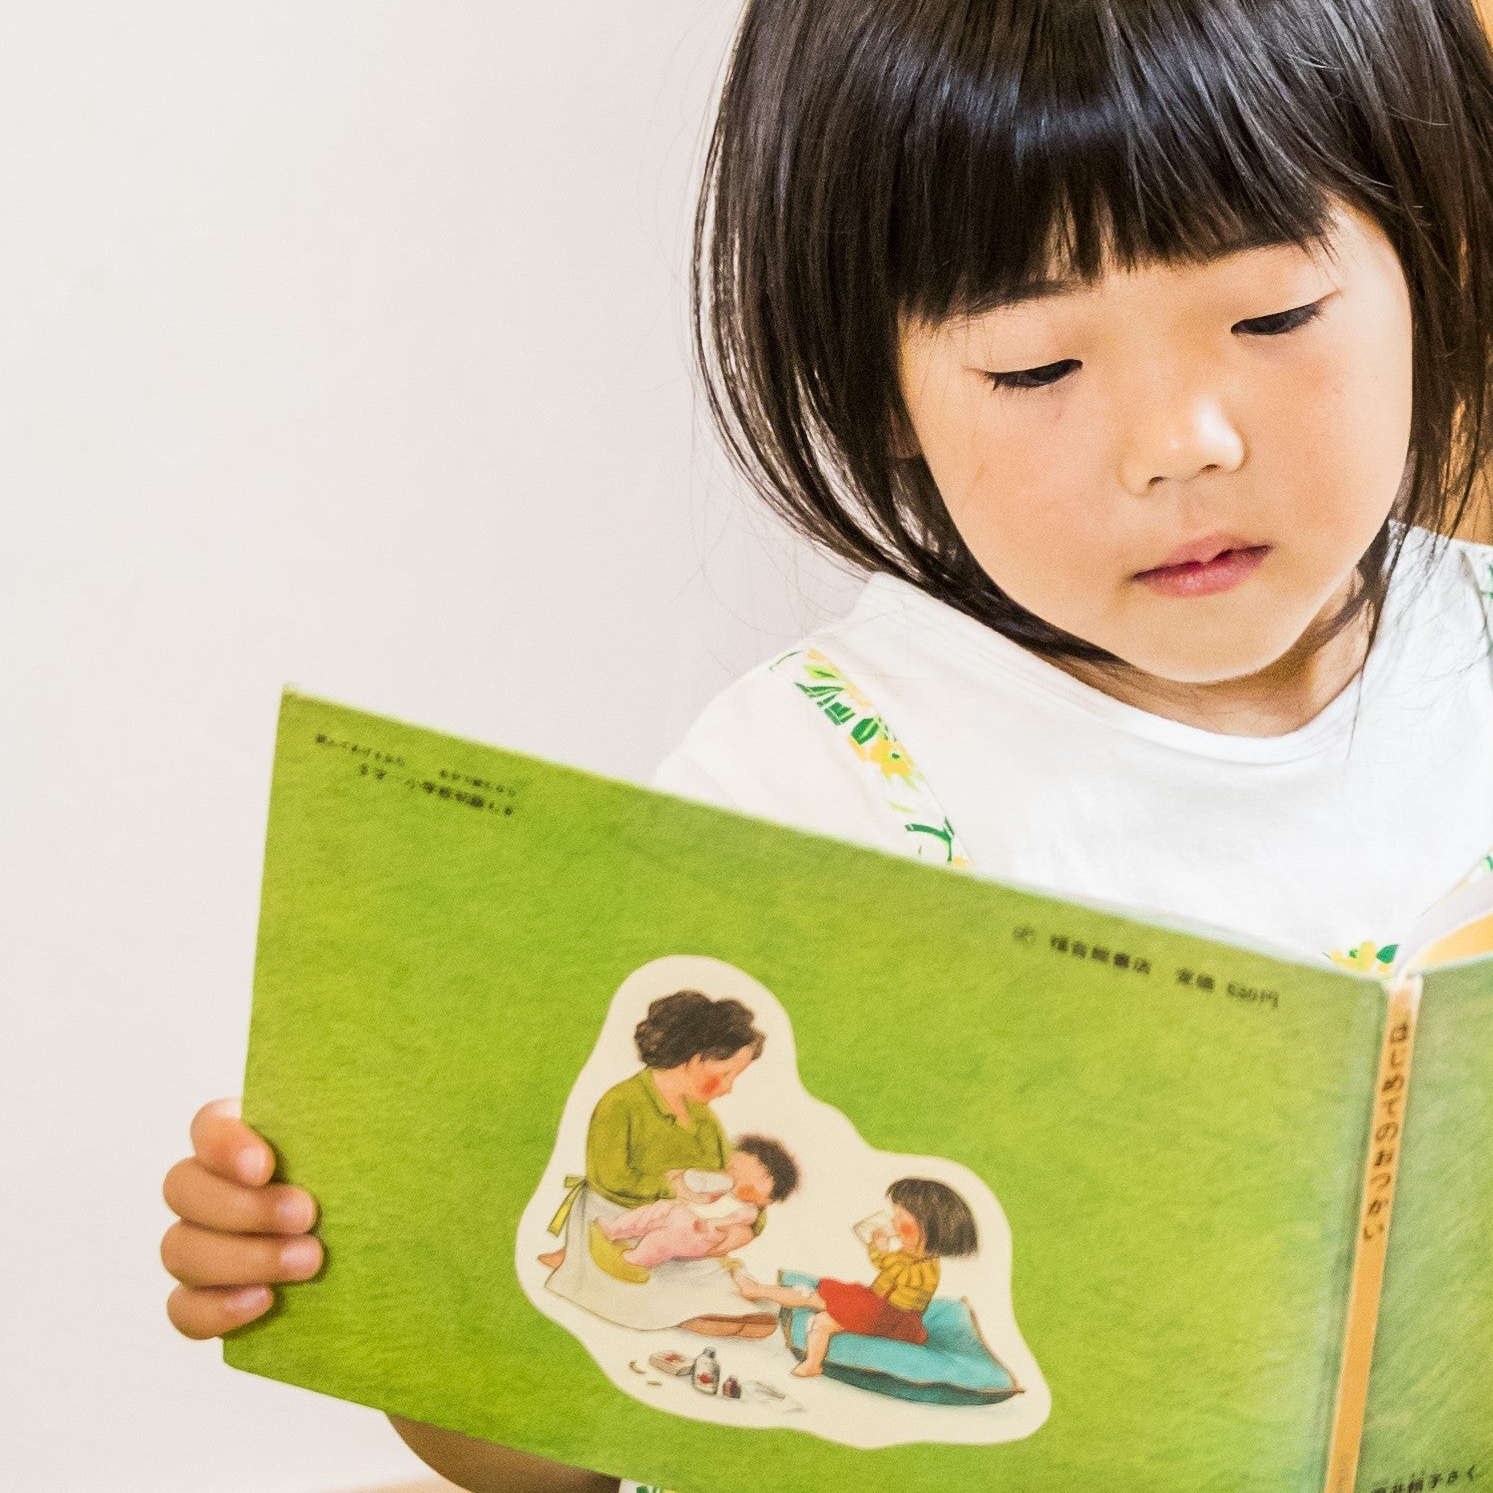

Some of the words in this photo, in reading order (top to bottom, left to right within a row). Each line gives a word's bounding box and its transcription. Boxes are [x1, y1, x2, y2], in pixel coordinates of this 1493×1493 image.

[1363, 1022, 1409, 1241] はじめてのおつかい
